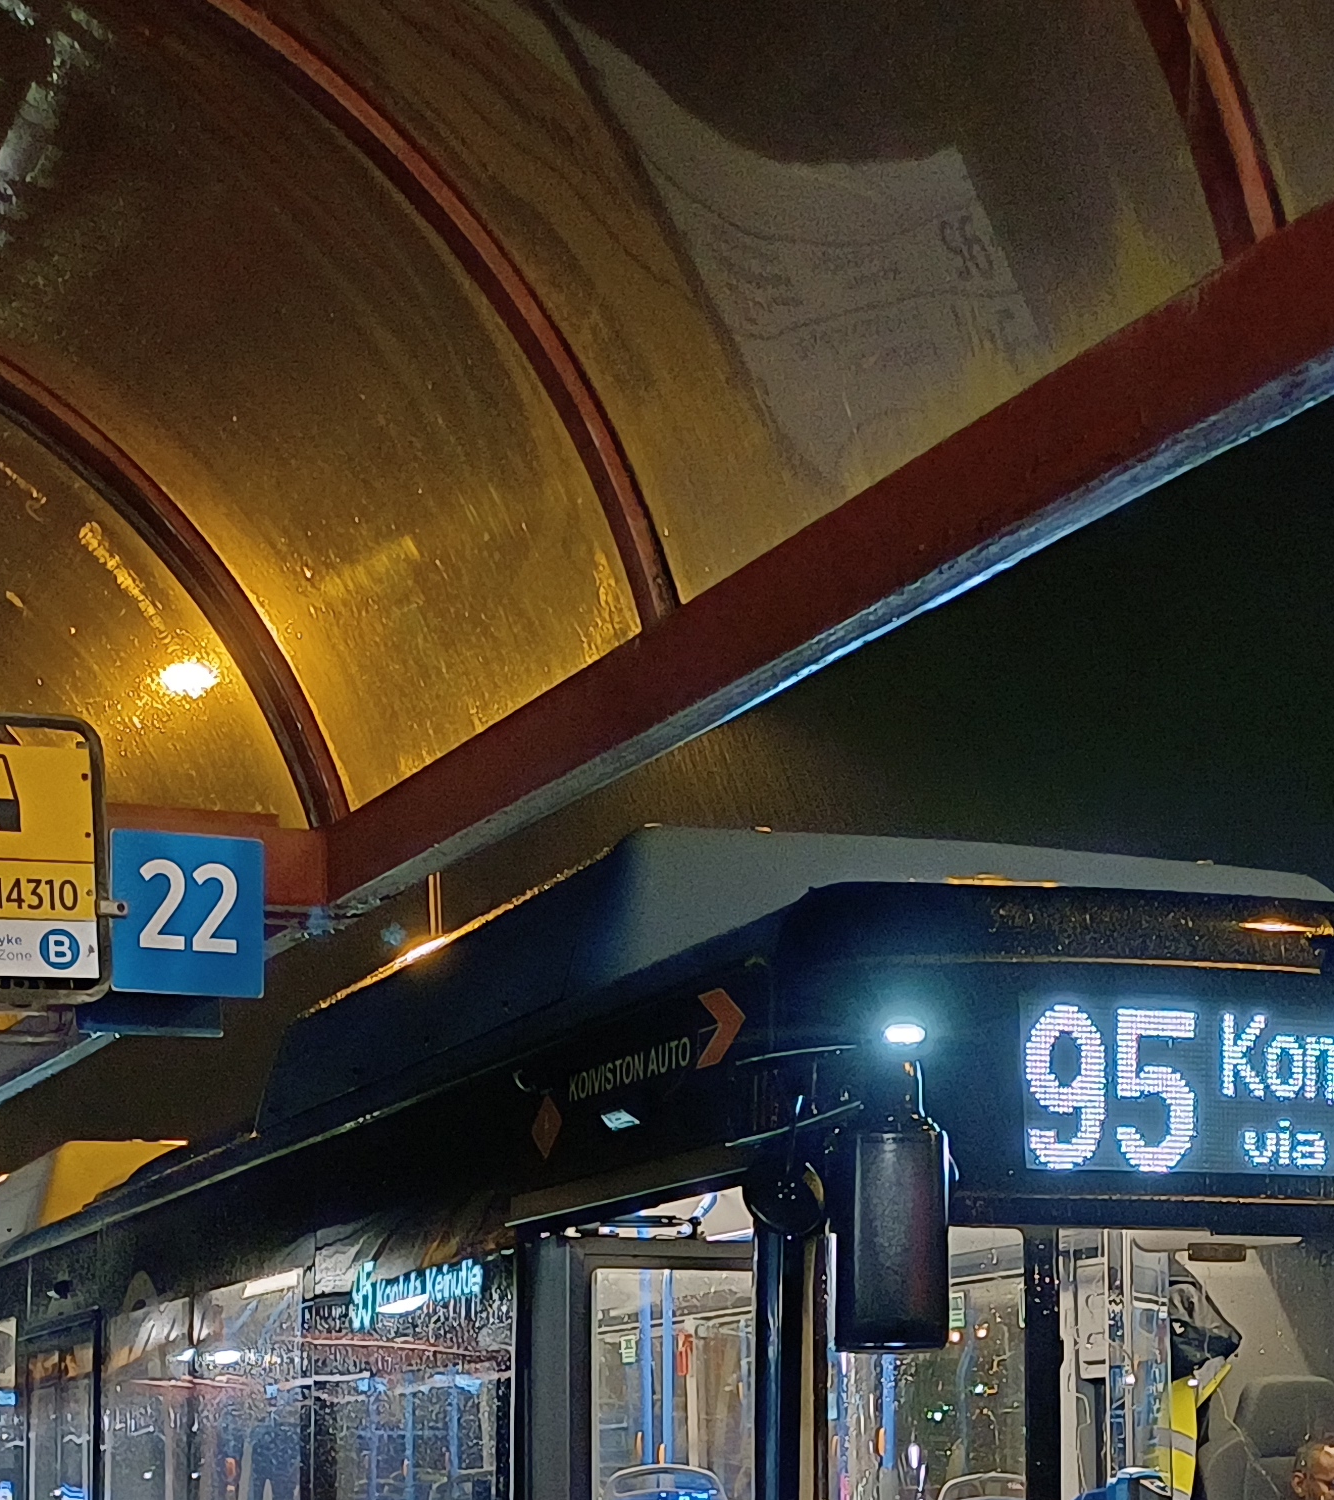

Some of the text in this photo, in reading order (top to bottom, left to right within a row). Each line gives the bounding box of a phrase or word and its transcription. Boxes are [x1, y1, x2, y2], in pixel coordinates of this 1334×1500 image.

[137, 858, 239, 956] 22
[47, 934, 73, 964] B
[568, 1036, 691, 1102] KOIVISTON AUTO
[1023, 1002, 1199, 1173] 95
[1242, 1118, 1328, 1170] via
